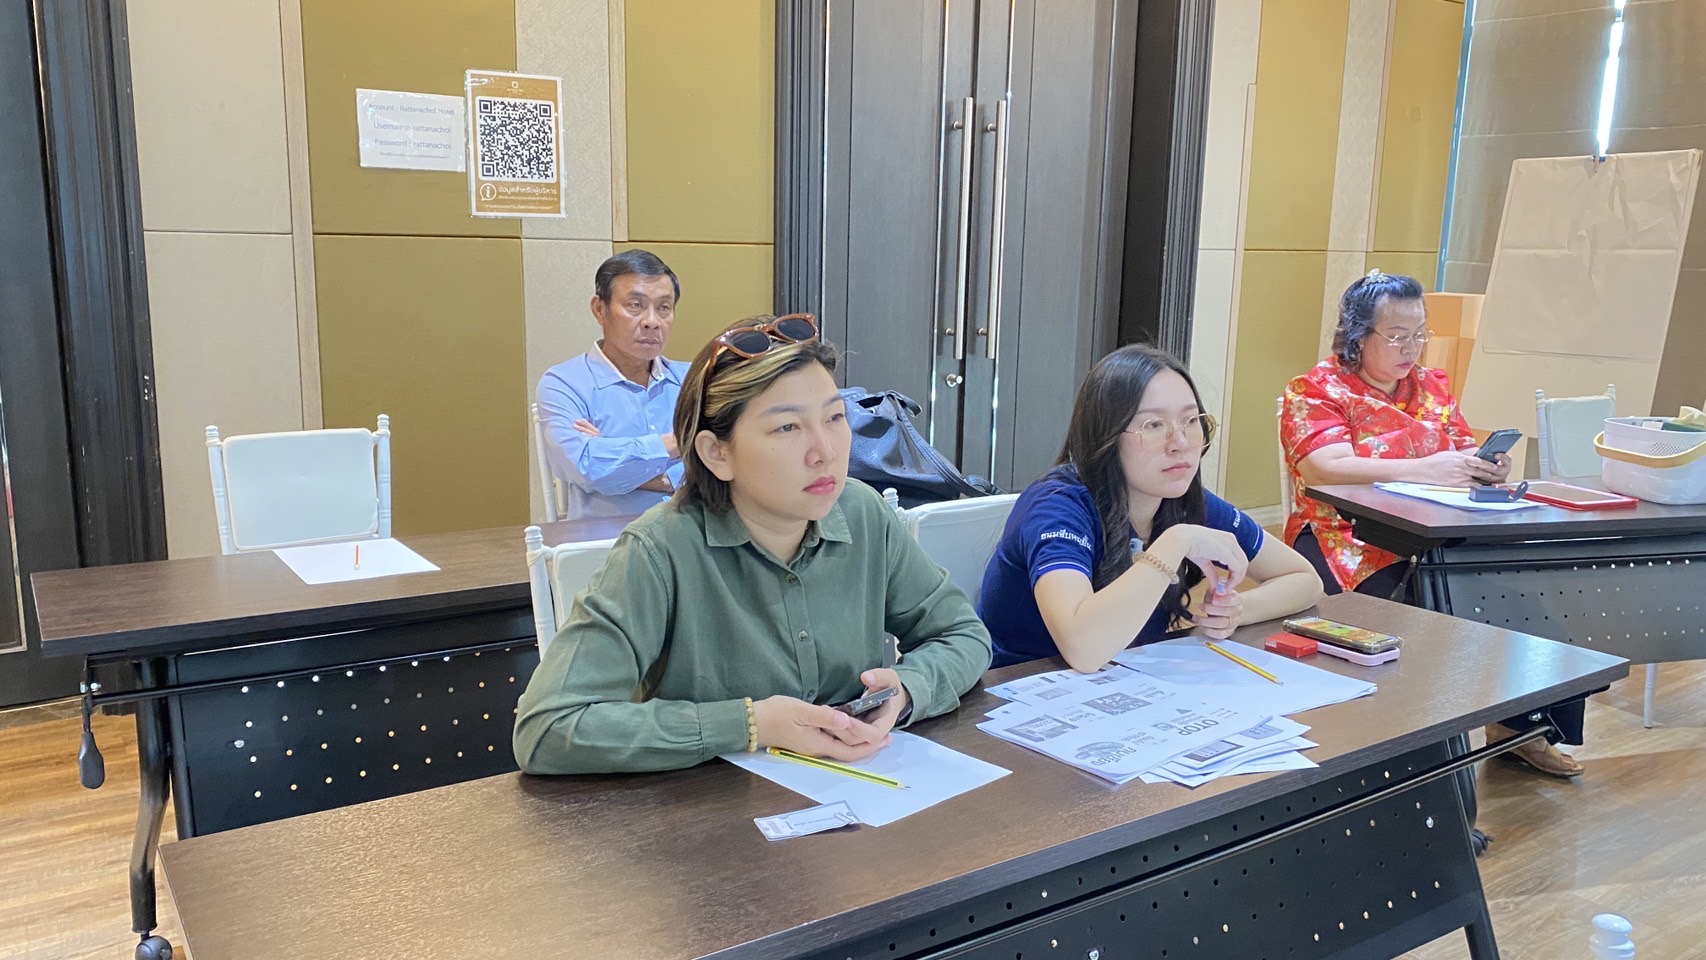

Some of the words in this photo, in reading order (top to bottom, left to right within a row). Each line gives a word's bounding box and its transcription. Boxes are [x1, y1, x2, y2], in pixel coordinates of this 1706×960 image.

[369, 103, 395, 112] Account
[400, 105, 437, 115] Rattanachol
[438, 108, 455, 116] Hotel
[412, 125, 452, 134] rattanachol
[374, 138, 407, 148] Password
[413, 140, 452, 150] rattanachol
[1177, 719, 1219, 736] OTOP
